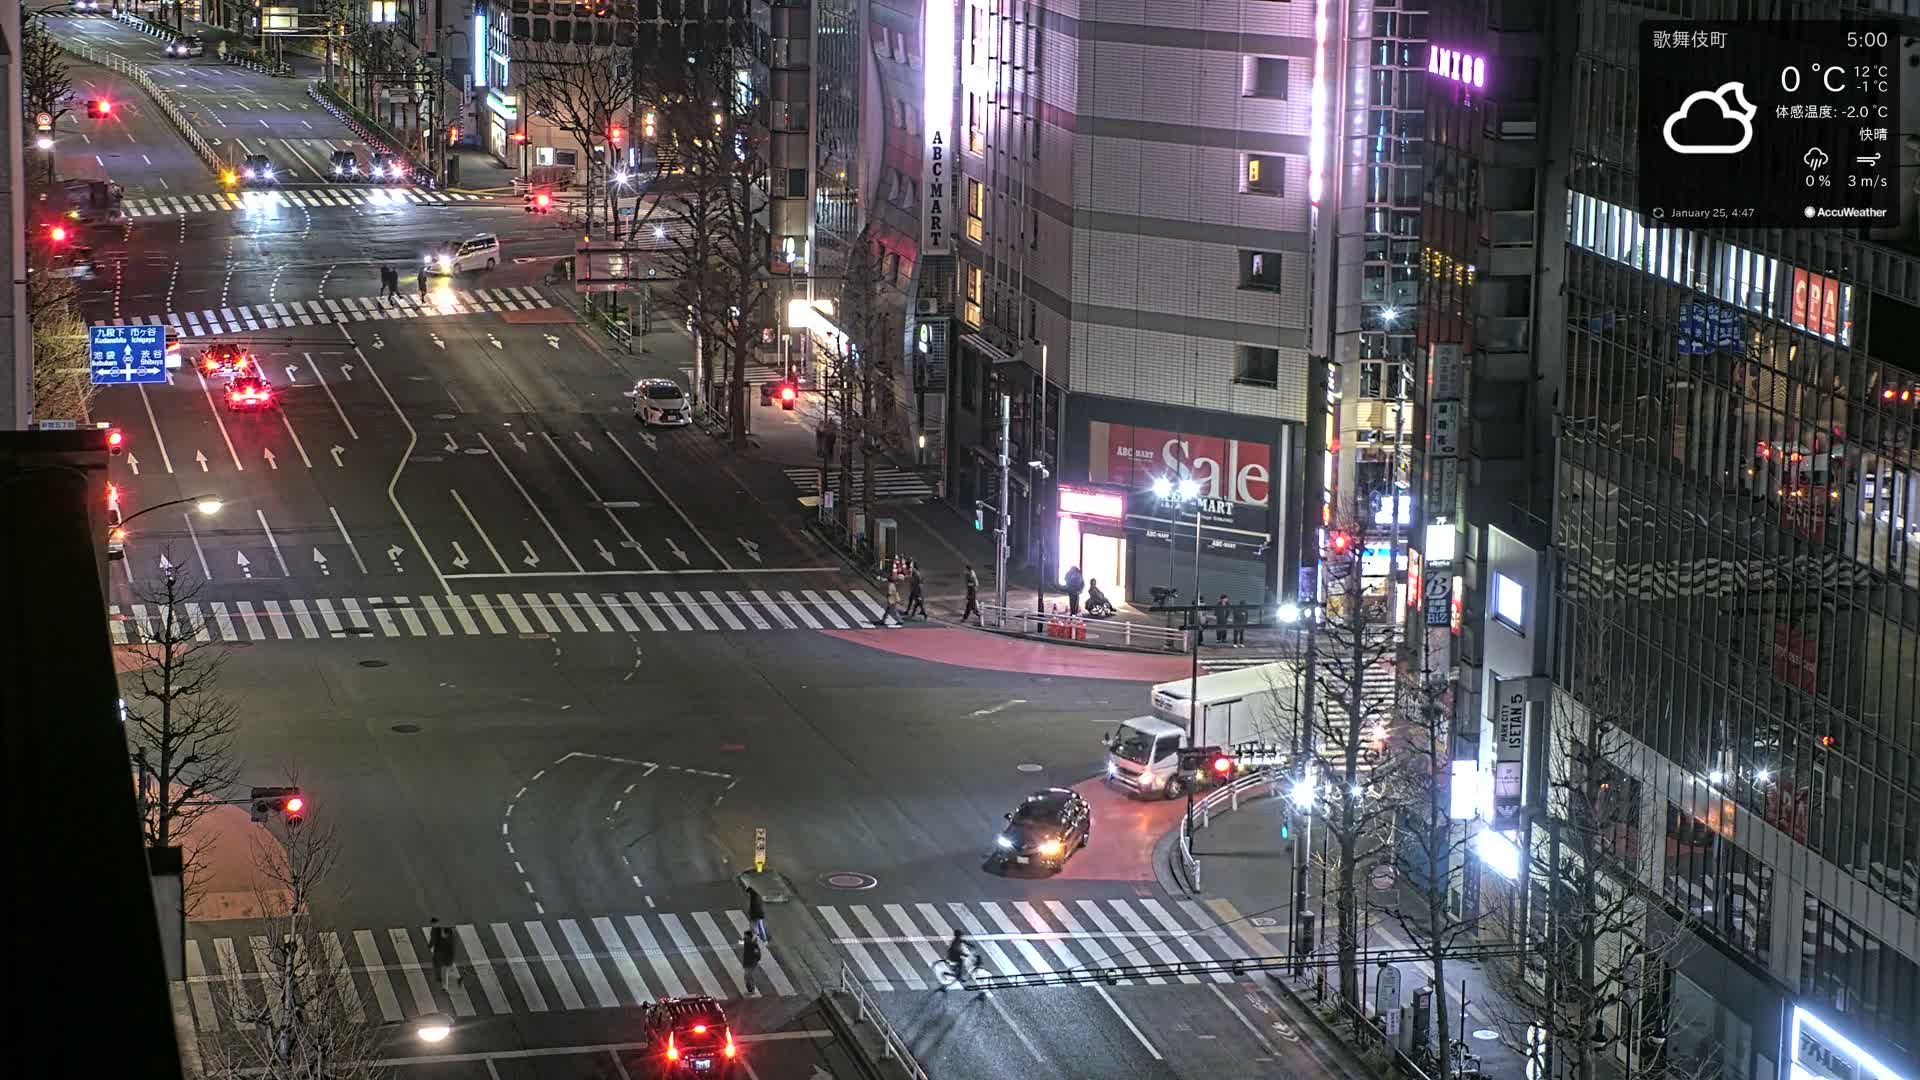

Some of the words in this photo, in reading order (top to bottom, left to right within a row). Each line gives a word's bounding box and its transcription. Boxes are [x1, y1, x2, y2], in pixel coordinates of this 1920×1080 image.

[930, 131, 943, 246] ABC-MART
[1795, 280, 1836, 321] CPA
[1162, 438, 1269, 507] Sale
[1501, 704, 1509, 722] CITY
[1511, 693, 1523, 705] 5
[1500, 723, 1509, 742] PARK
[1508, 707, 1522, 748] ISETAN
